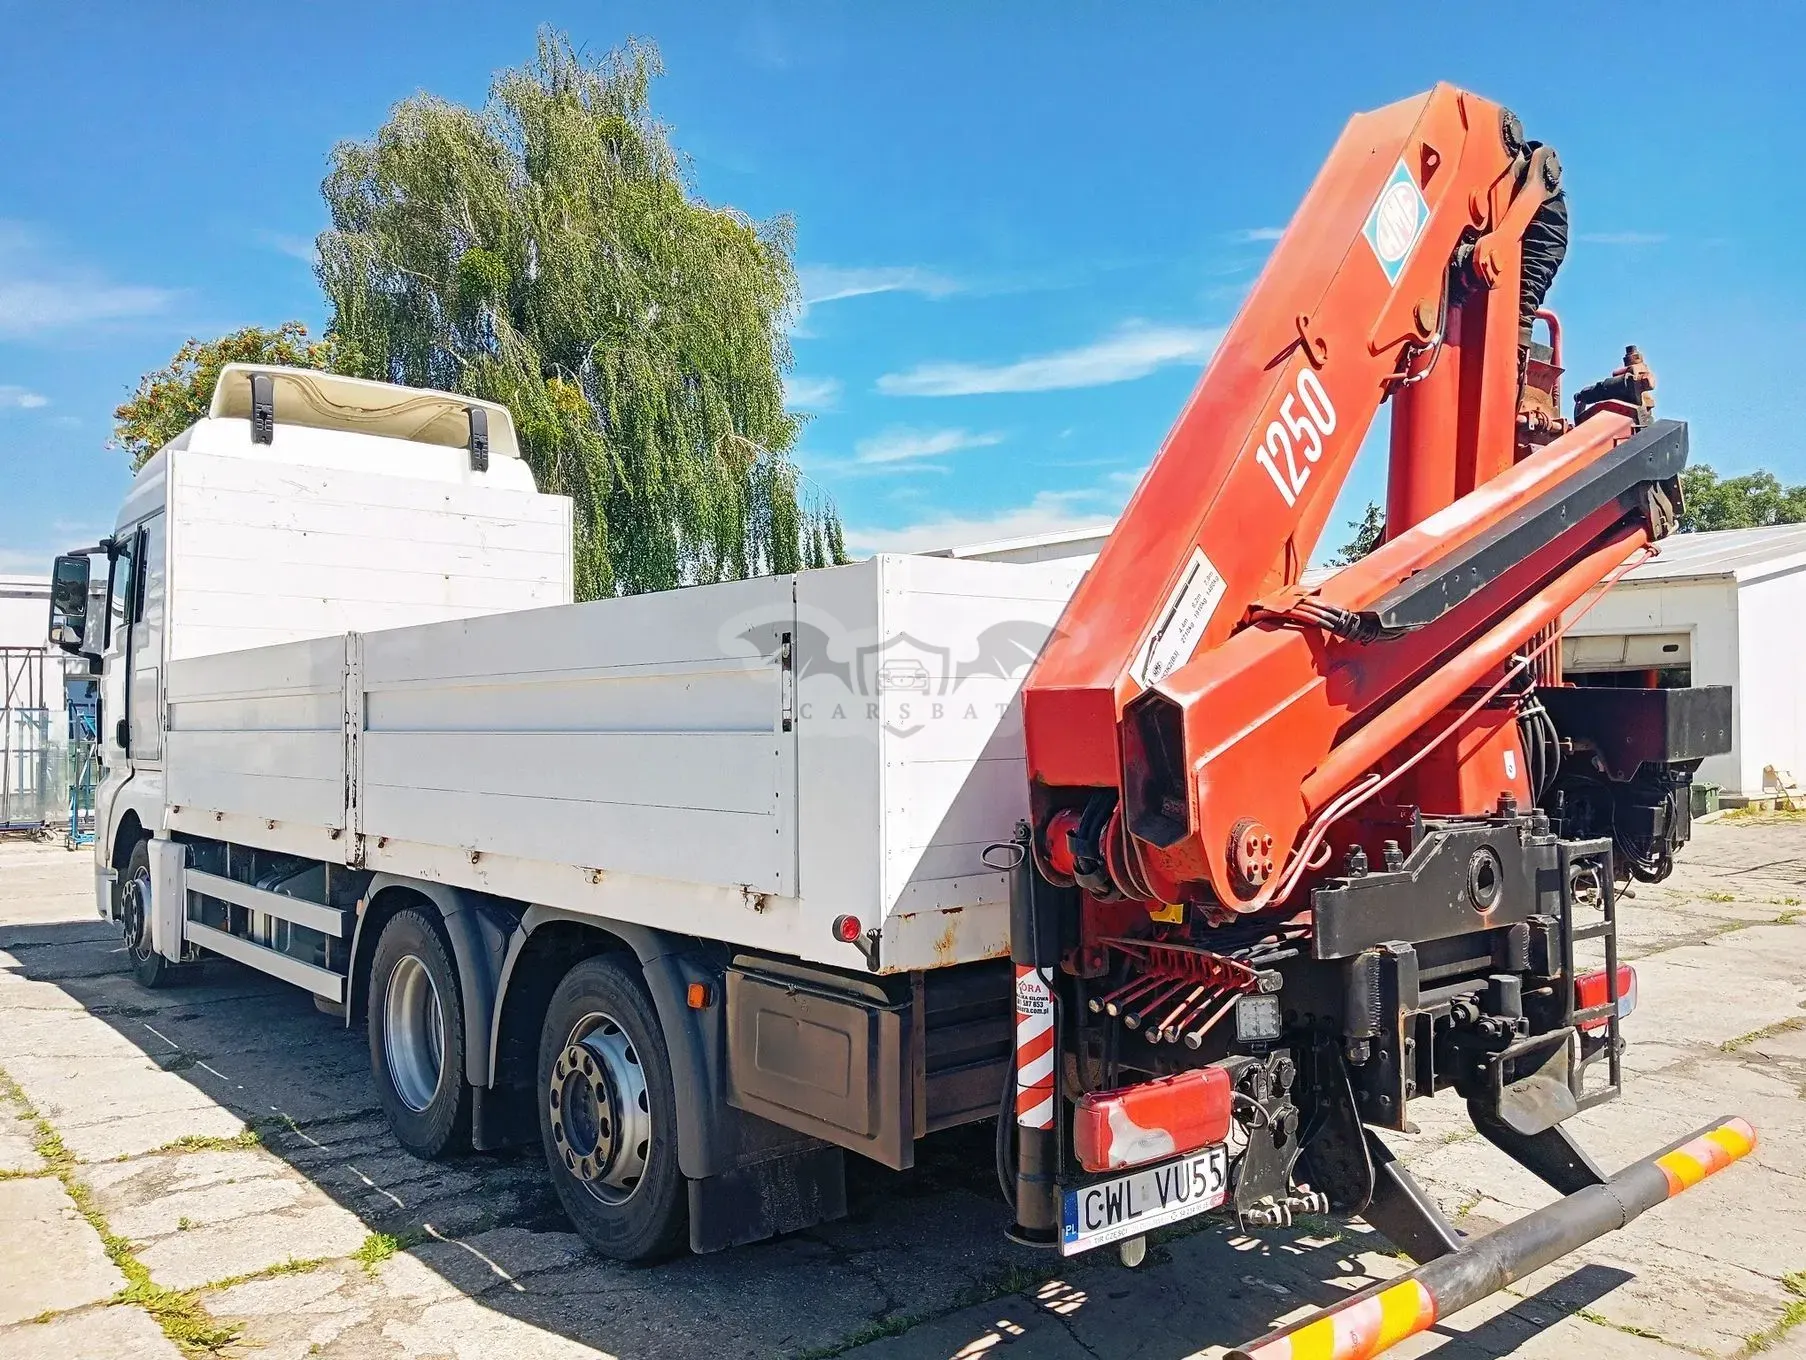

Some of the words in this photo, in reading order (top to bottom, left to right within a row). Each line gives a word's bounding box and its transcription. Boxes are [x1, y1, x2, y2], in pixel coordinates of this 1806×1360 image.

[1256, 367, 1336, 508] 1250
[1065, 1224, 1077, 1236] PL
[1085, 1180, 1142, 1230] CWL
[1155, 1153, 1222, 1208] VU55
